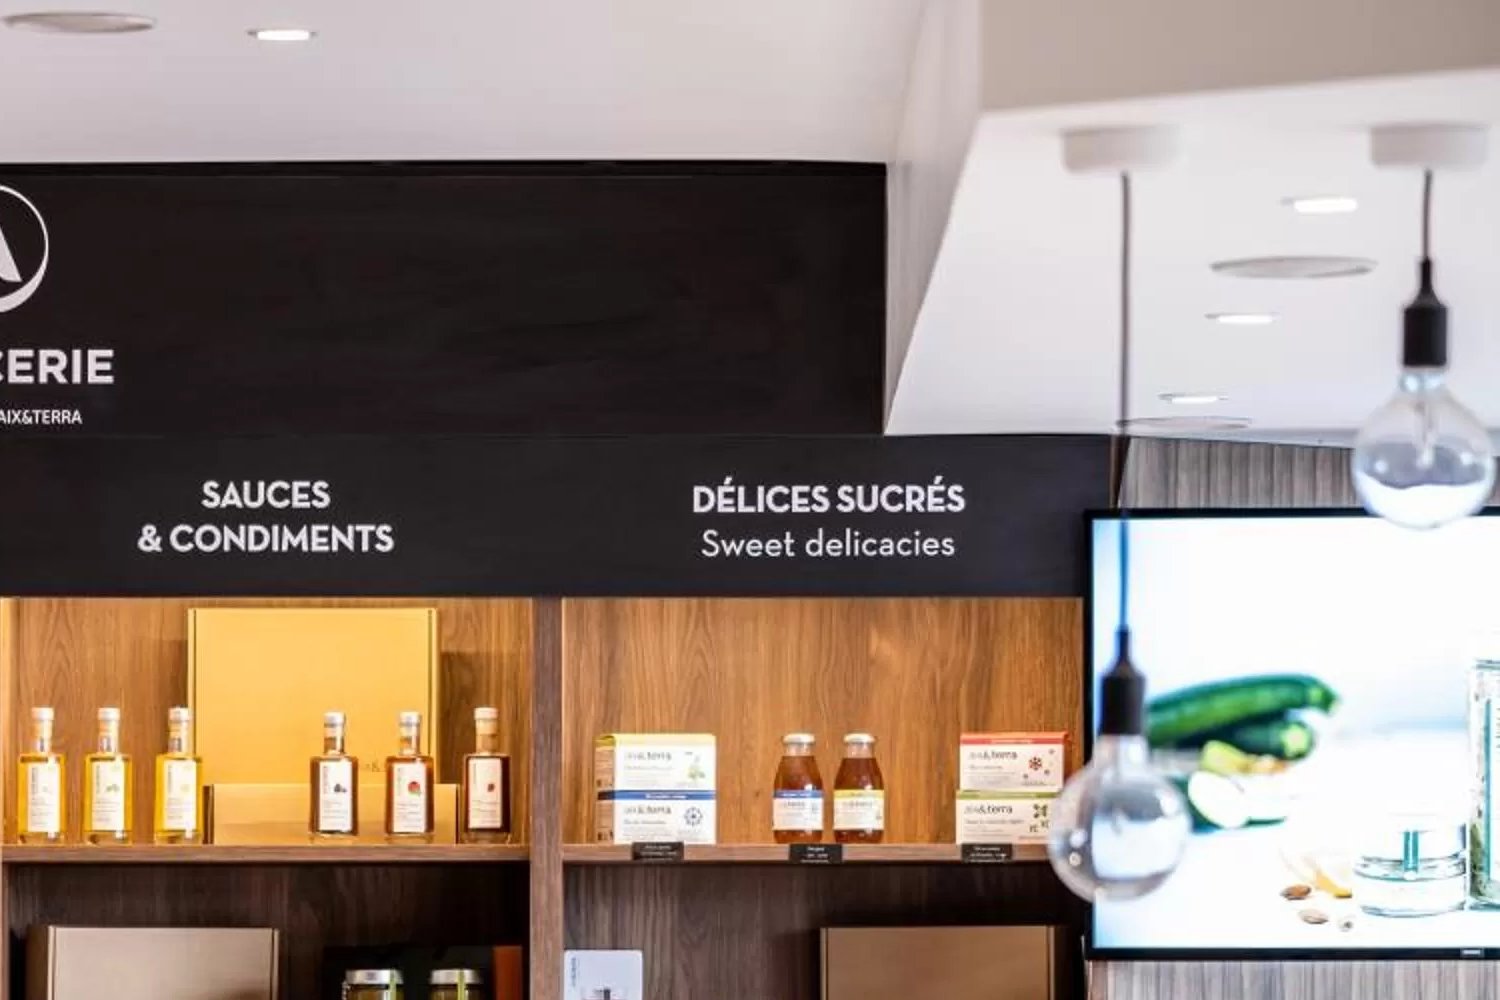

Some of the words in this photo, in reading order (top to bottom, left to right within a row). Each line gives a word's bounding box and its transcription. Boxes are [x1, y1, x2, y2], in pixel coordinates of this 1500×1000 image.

[202, 480, 330, 509] SAUCES
[693, 477, 830, 513] DÉLICES
[836, 476, 965, 513] SUCRÉS
[137, 524, 162, 552] &
[169, 523, 394, 552] CONDIMENTS
[701, 529, 795, 557] Sweet
[805, 528, 955, 557] delicacies
